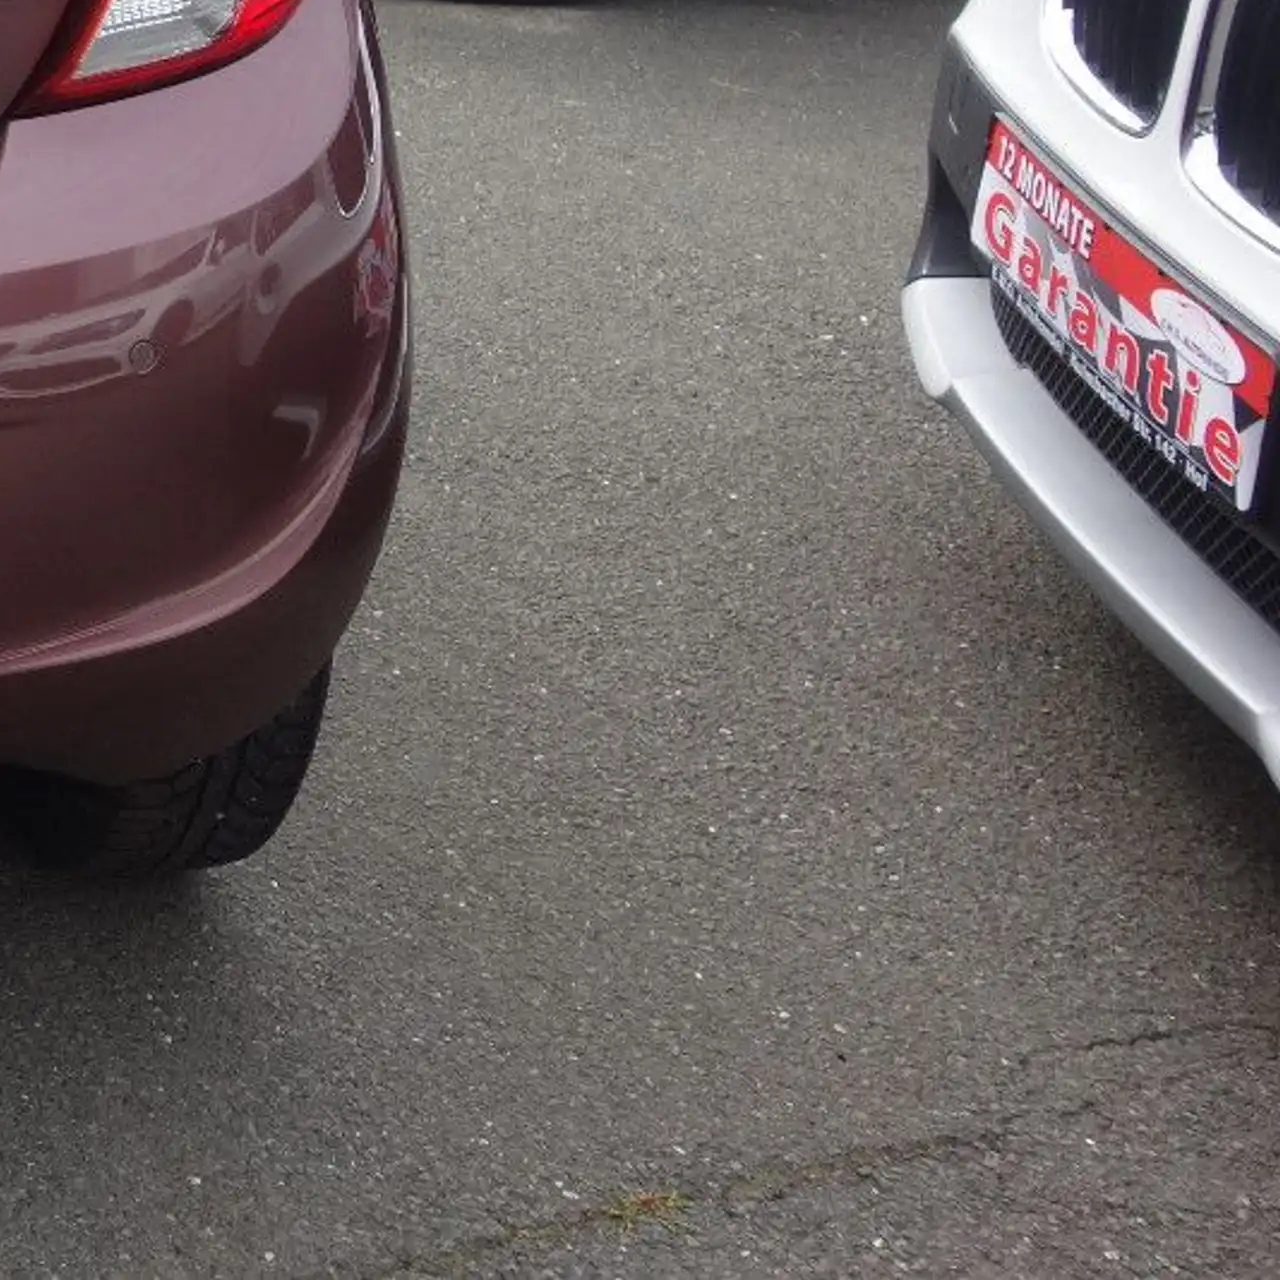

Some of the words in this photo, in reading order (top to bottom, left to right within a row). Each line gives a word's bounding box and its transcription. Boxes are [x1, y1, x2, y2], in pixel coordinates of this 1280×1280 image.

[998, 135, 1016, 180] 12
[1016, 154, 1095, 260] MONATE
[984, 191, 1242, 487] Garantie
